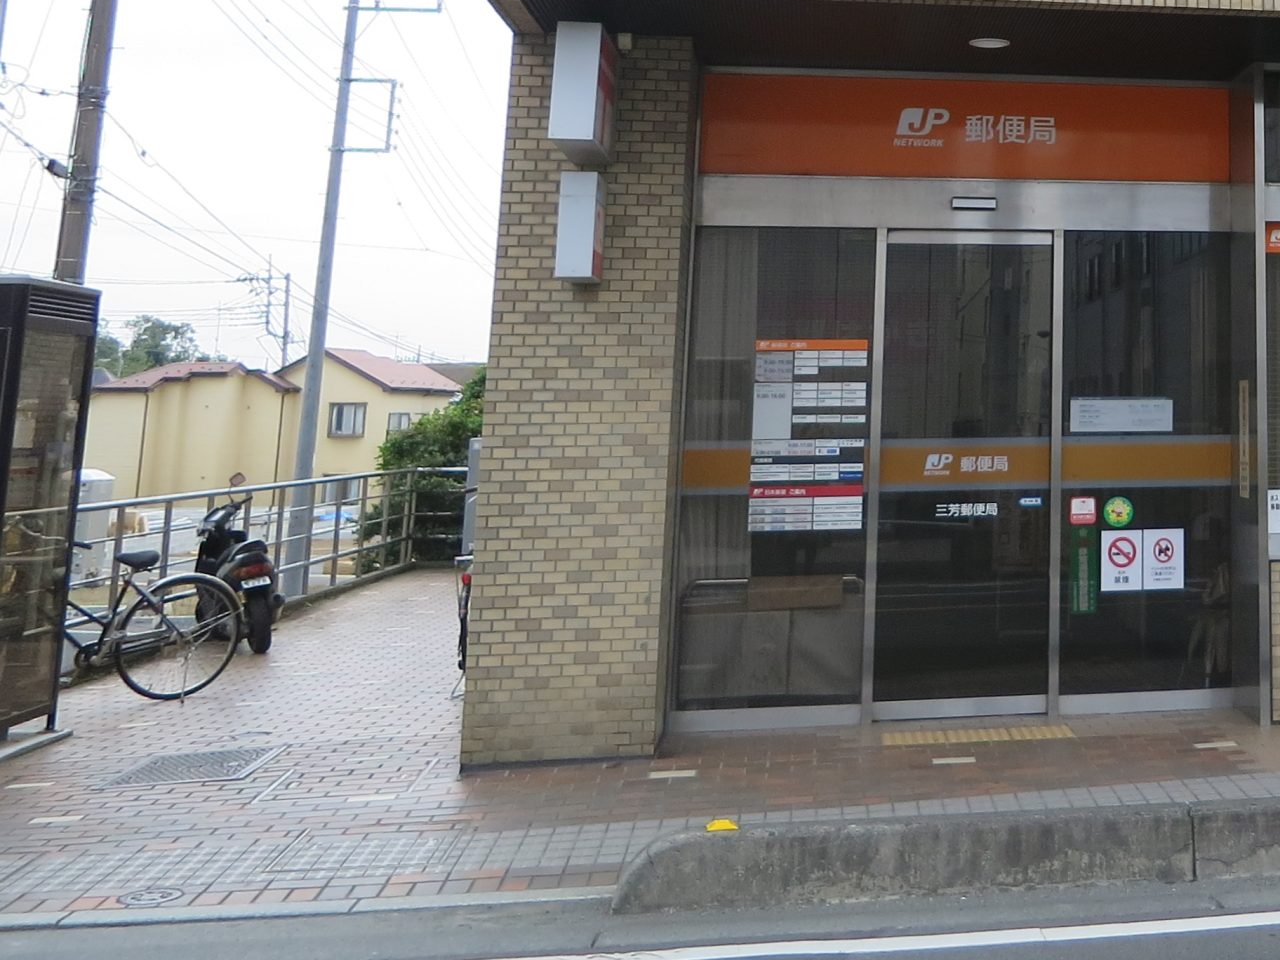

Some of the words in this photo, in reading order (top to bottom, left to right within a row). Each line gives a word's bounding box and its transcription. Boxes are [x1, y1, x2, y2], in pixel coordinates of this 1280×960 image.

[965, 114, 1056, 144] 郵便局
[893, 138, 944, 147] NETWORK
[960, 455, 1009, 472] 郵便局
[935, 502, 998, 517] 三芳郵便局
